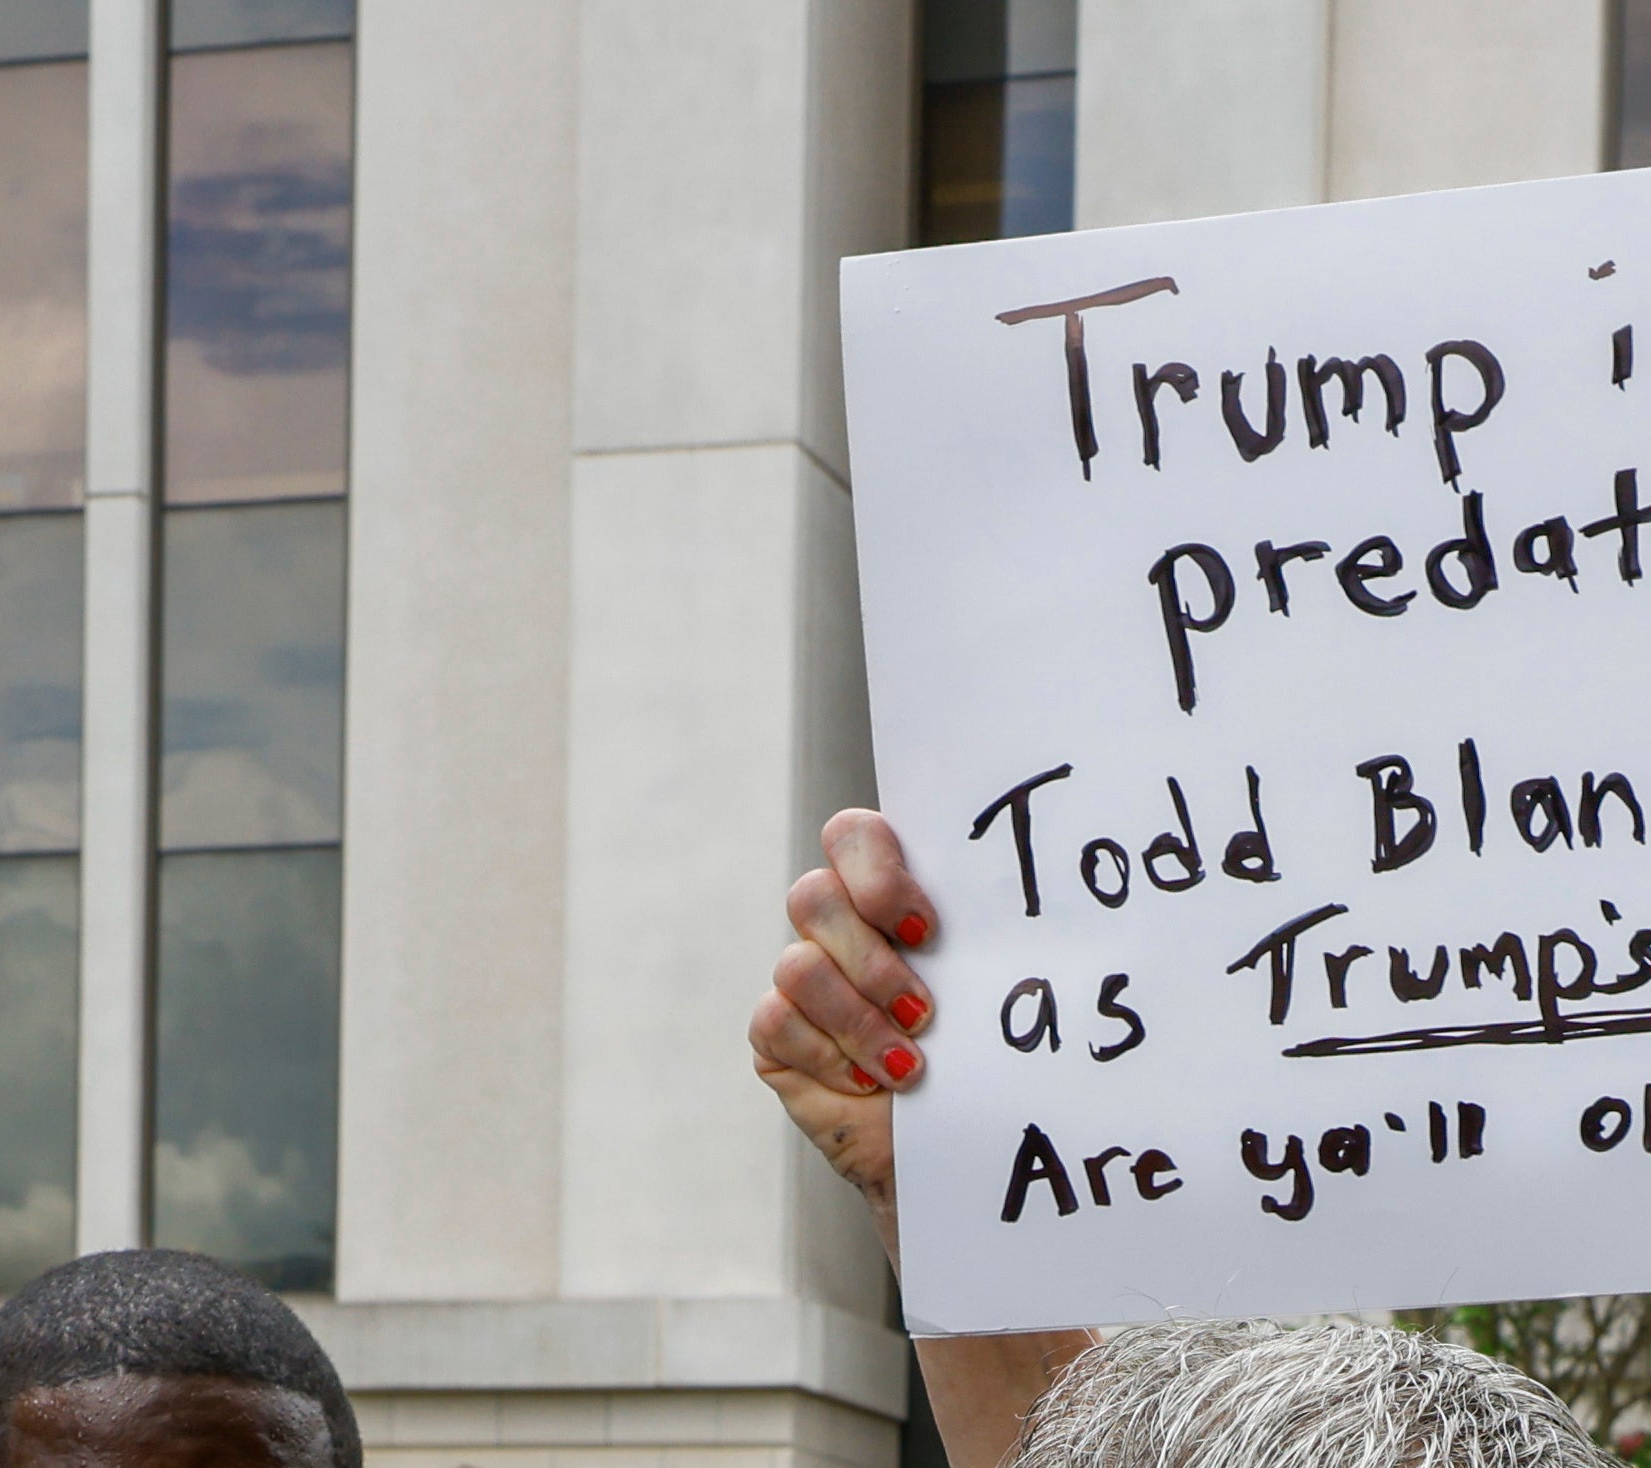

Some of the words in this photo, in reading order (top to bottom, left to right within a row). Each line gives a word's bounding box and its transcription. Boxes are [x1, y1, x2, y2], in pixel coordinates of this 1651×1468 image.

[996, 275, 1507, 494] Trump
[968, 763, 1282, 918] Todd
[1000, 972, 1146, 1063] as
[1000, 1122, 1184, 1224] Are
[1240, 1100, 1486, 1222] ya'll
